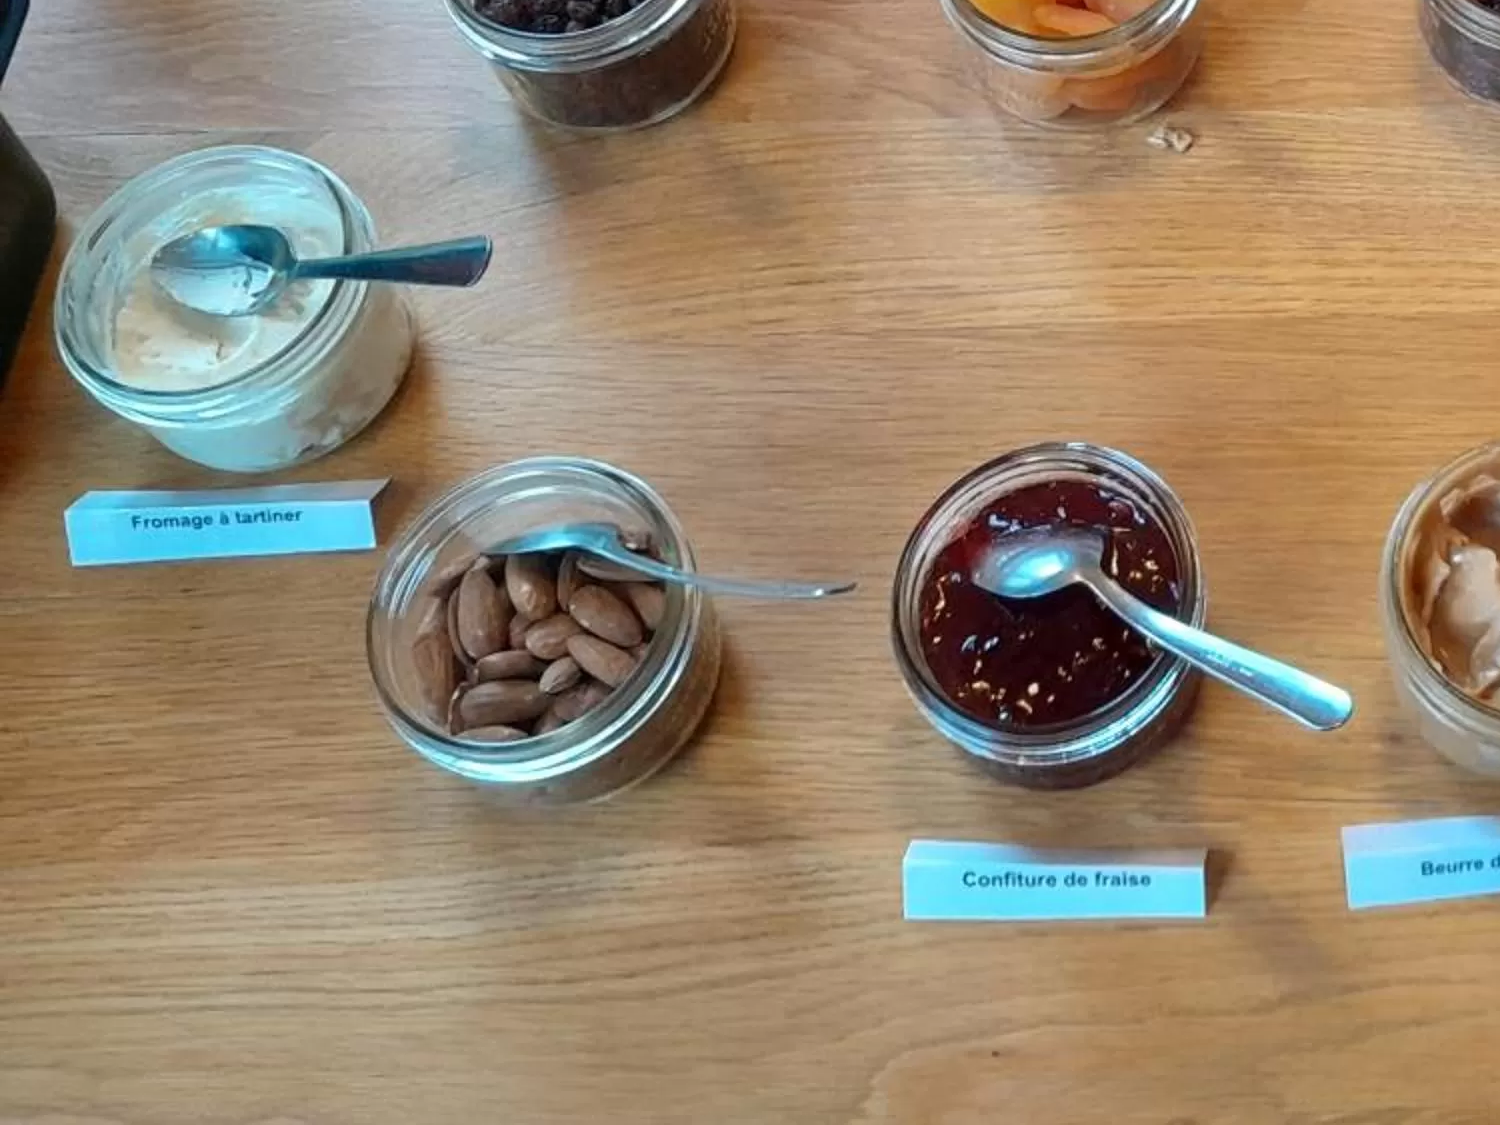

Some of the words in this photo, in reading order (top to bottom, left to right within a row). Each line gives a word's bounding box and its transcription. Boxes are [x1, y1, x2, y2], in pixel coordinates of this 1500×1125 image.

[131, 514, 214, 530] Fromage
[219, 511, 229, 525] à
[235, 509, 303, 524] tartiner
[1420, 858, 1484, 876] Beurre
[962, 870, 1057, 888] Confiture
[1063, 871, 1088, 887] de
[1095, 871, 1152, 888] fraise
